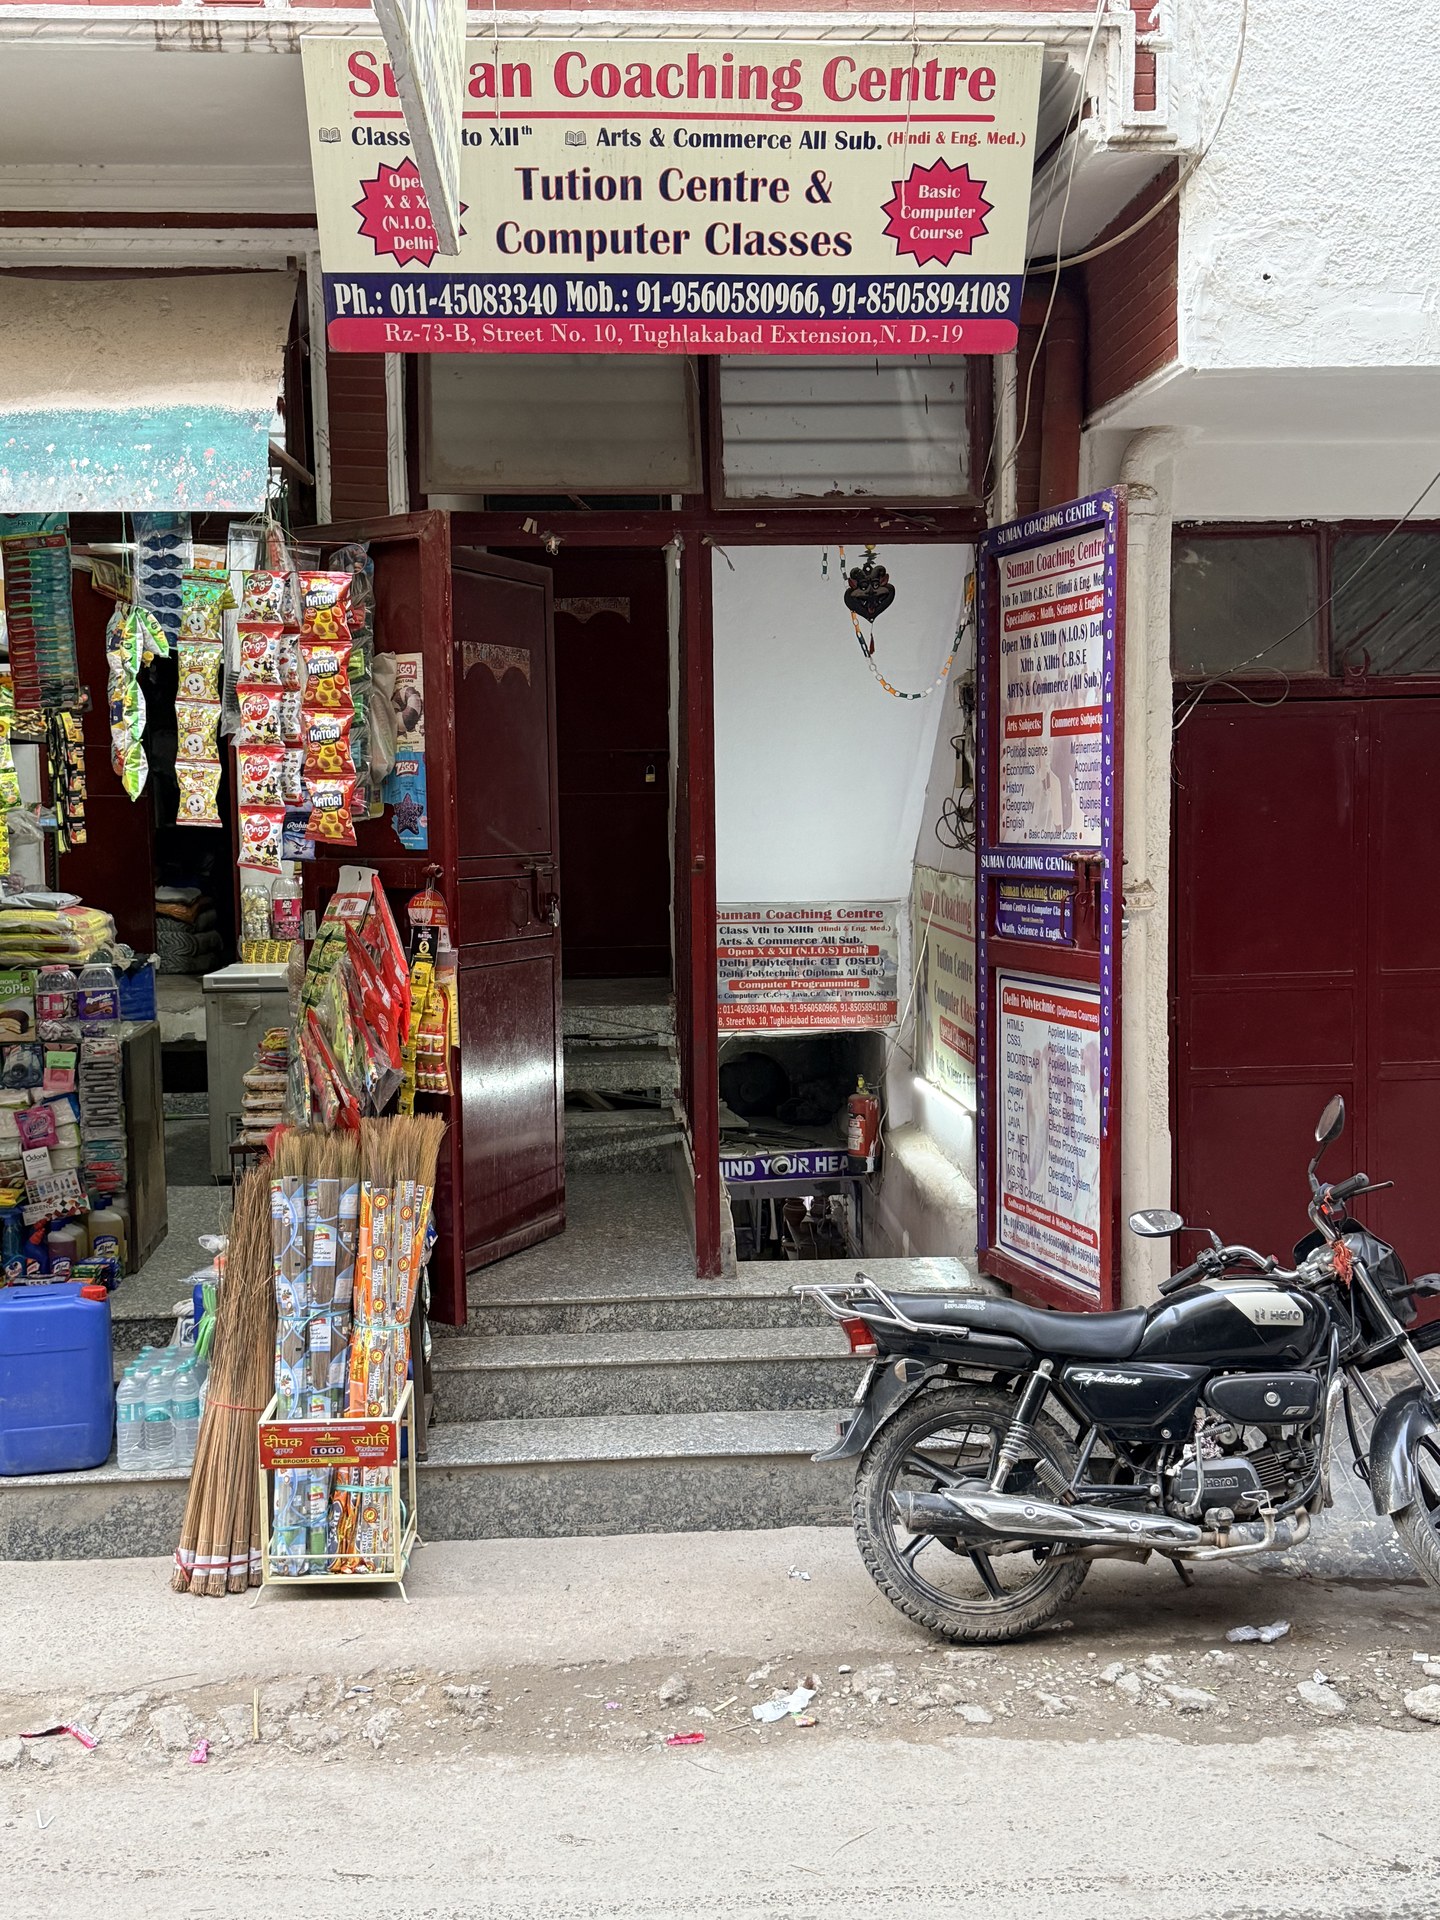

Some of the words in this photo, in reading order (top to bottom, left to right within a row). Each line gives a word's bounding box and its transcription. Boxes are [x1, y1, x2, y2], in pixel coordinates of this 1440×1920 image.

[553, 51, 804, 112] Coaching
[822, 56, 997, 102] Centre
[351, 126, 411, 147] Class
[461, 128, 482, 147] to
[596, 128, 641, 147] Arts
[648, 128, 666, 147] &
[673, 128, 792, 150] Commerce
[799, 130, 827, 150] All
[834, 130, 883, 150] Sub.
[886, 131, 931, 148] (Hindi
[935, 132, 946, 145] &
[950, 132, 982, 147] Eng.
[986, 132, 1027, 147] Med.)
[513, 167, 643, 202] Tution
[659, 168, 790, 204] Centre
[804, 169, 833, 204] &
[918, 184, 961, 200] Basic
[383, 195, 395, 209] X
[399, 195, 411, 210] &
[900, 204, 976, 223] Computer
[910, 225, 964, 241] Course
[393, 236, 434, 251] Delhi
[496, 221, 690, 263] Computer
[705, 222, 853, 258] Classes
[333, 283, 383, 315] Ph.:
[390, 283, 557, 316] 011-45083340
[566, 280, 628, 314] Mob.:
[636, 281, 826, 318] 91-9560580966,
[831, 281, 1011, 315] 91-8505894108
[384, 323, 477, 346] Rz-73-B,
[482, 323, 545, 343] Street
[551, 323, 586, 343] No.
[595, 324, 624, 346] 10,
[629, 323, 763, 349] Tughlakabad
[909, 325, 964, 344] D.-19
[997, 526, 1023, 545] SUMAN
[1065, 499, 1098, 524] CENTRE
[1006, 559, 1035, 580] Suman
[1036, 545, 1076, 572] Coaching
[1056, 602, 1078, 617] Science
[1001, 638, 1018, 656] Open
[1007, 682, 1024, 699] ARTS
[1032, 676, 1069, 696] Commerce
[1006, 720, 1018, 732] Arts
[1027, 744, 1048, 758] science
[1006, 762, 1035, 776] Economics
[1005, 781, 1025, 796] History
[1005, 798, 1035, 813] Geography
[1005, 816, 1025, 833] English
[981, 855, 1005, 869] SUMAN
[1006, 855, 1044, 870] COACHING
[999, 882, 1020, 898] Suman
[1020, 883, 1048, 903] Coaching
[716, 910, 761, 920] Suman
[766, 909, 833, 921] Coaching
[836, 909, 884, 919] Centre
[719, 926, 749, 935] Class
[752, 926, 770, 934] Vth
[773, 926, 784, 934] to
[1017, 924, 1039, 937] Science
[719, 937, 742, 946] Arts
[745, 937, 754, 945] &
[757, 937, 818, 945] Commerce
[820, 936, 835, 945] All
[838, 935, 864, 945] Sub.
[727, 947, 754, 957] Open
[757, 947, 765, 955] X
[767, 947, 775, 955] &
[778, 947, 793, 955] XII
[796, 946, 840, 956] (N.I.O.S)
[719, 958, 749, 967] Delhi
[752, 958, 817, 968] Polytechnic
[845, 957, 884, 967] (DSEU)
[953, 953, 974, 985] Centre
[719, 970, 745, 978] Delhi
[746, 969, 800, 978] Polytechnic
[802, 969, 844, 977] (Diploma
[846, 969, 859, 977] All
[861, 968, 886, 977] Sub.)
[738, 981, 788, 990] Computer
[790, 979, 860, 989] Programming
[1003, 991, 1020, 1008] Delhi
[726, 1017, 745, 1026] Street
[760, 1157, 810, 1175] YUR
[815, 1155, 848, 1173] HEA
[1269, 1309, 1301, 1321] Hero
[263, 1434, 304, 1449] दीपक
[312, 1447, 343, 1455] 1000
[1205, 1477, 1234, 1488] Hero
